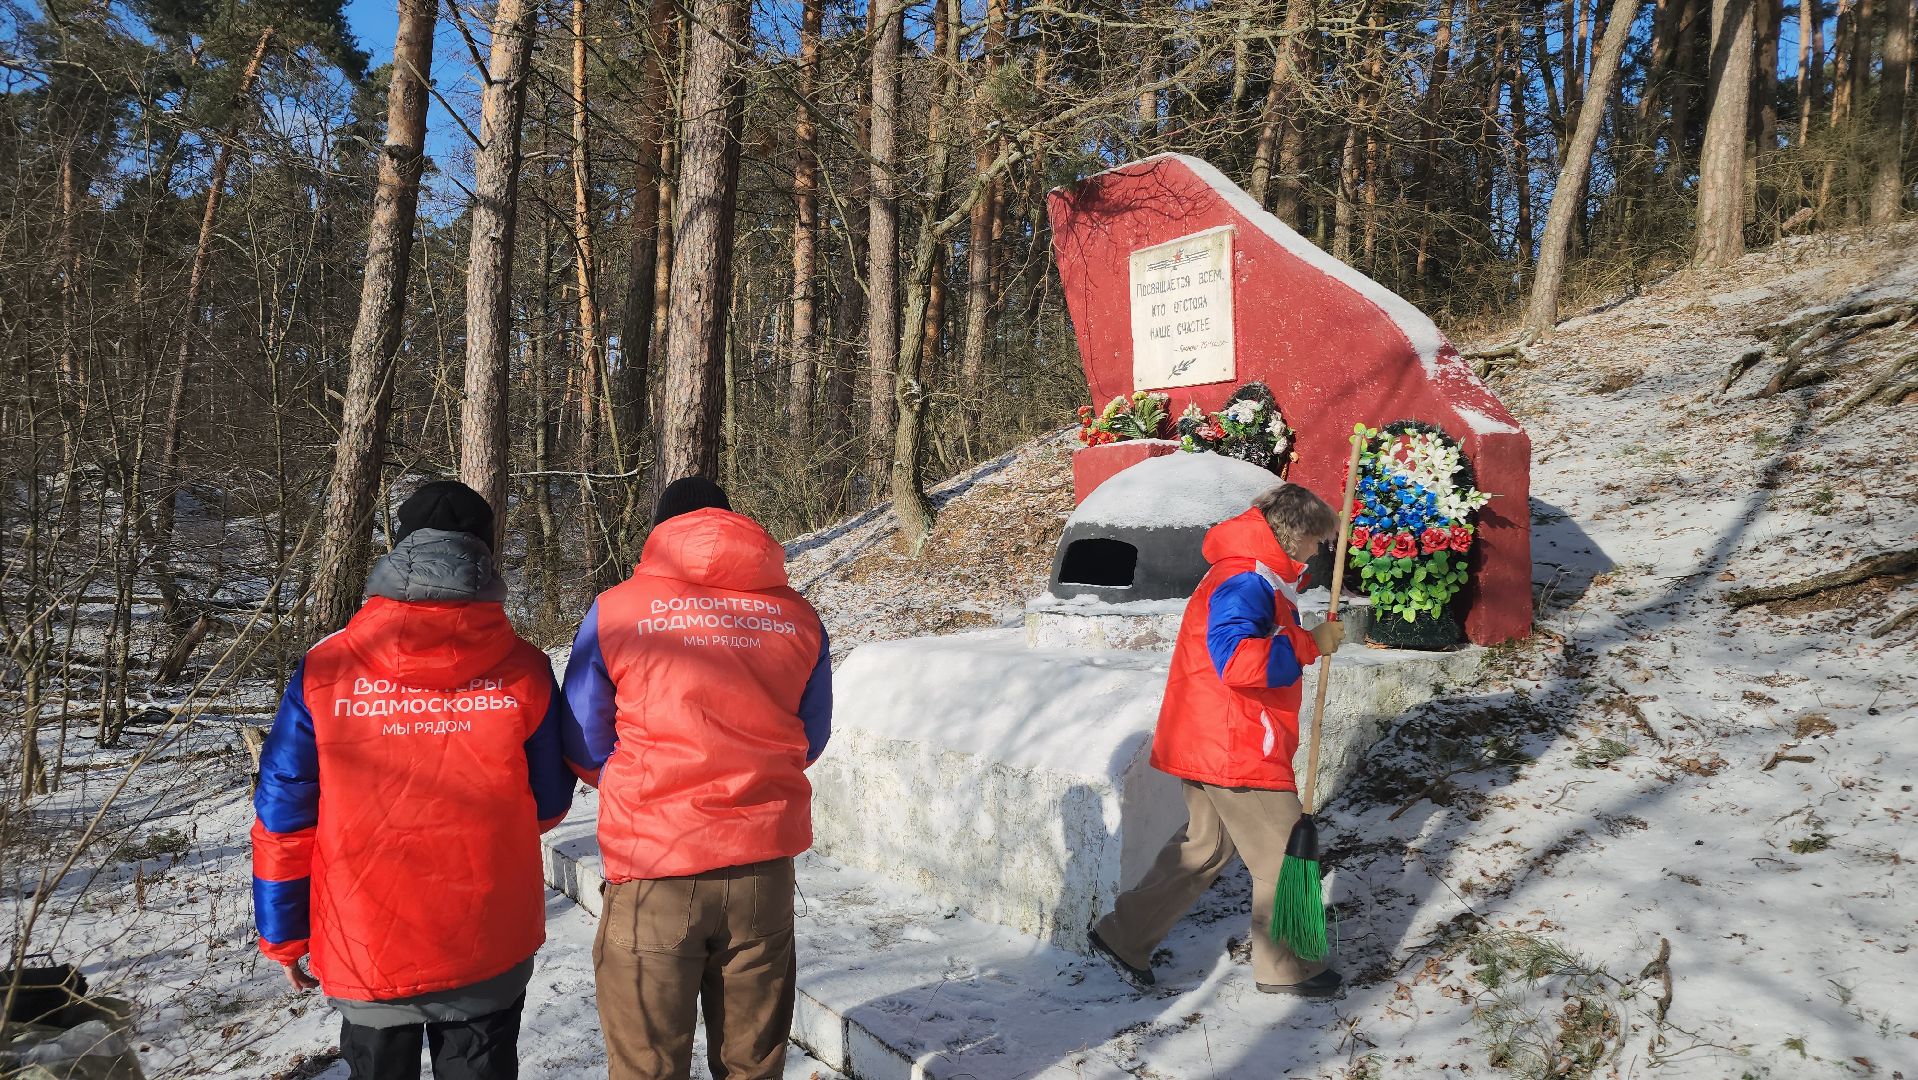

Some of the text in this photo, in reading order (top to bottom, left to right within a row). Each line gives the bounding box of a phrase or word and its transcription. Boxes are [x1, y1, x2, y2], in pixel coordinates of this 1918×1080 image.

[1151, 303, 1166, 318] КТО
[1150, 317, 1211, 340] НАШЕ СЧАСТЬЕ
[683, 636, 761, 649] МЫ РЯДОМ
[382, 720, 471, 736] МЫ РЯДОМ
